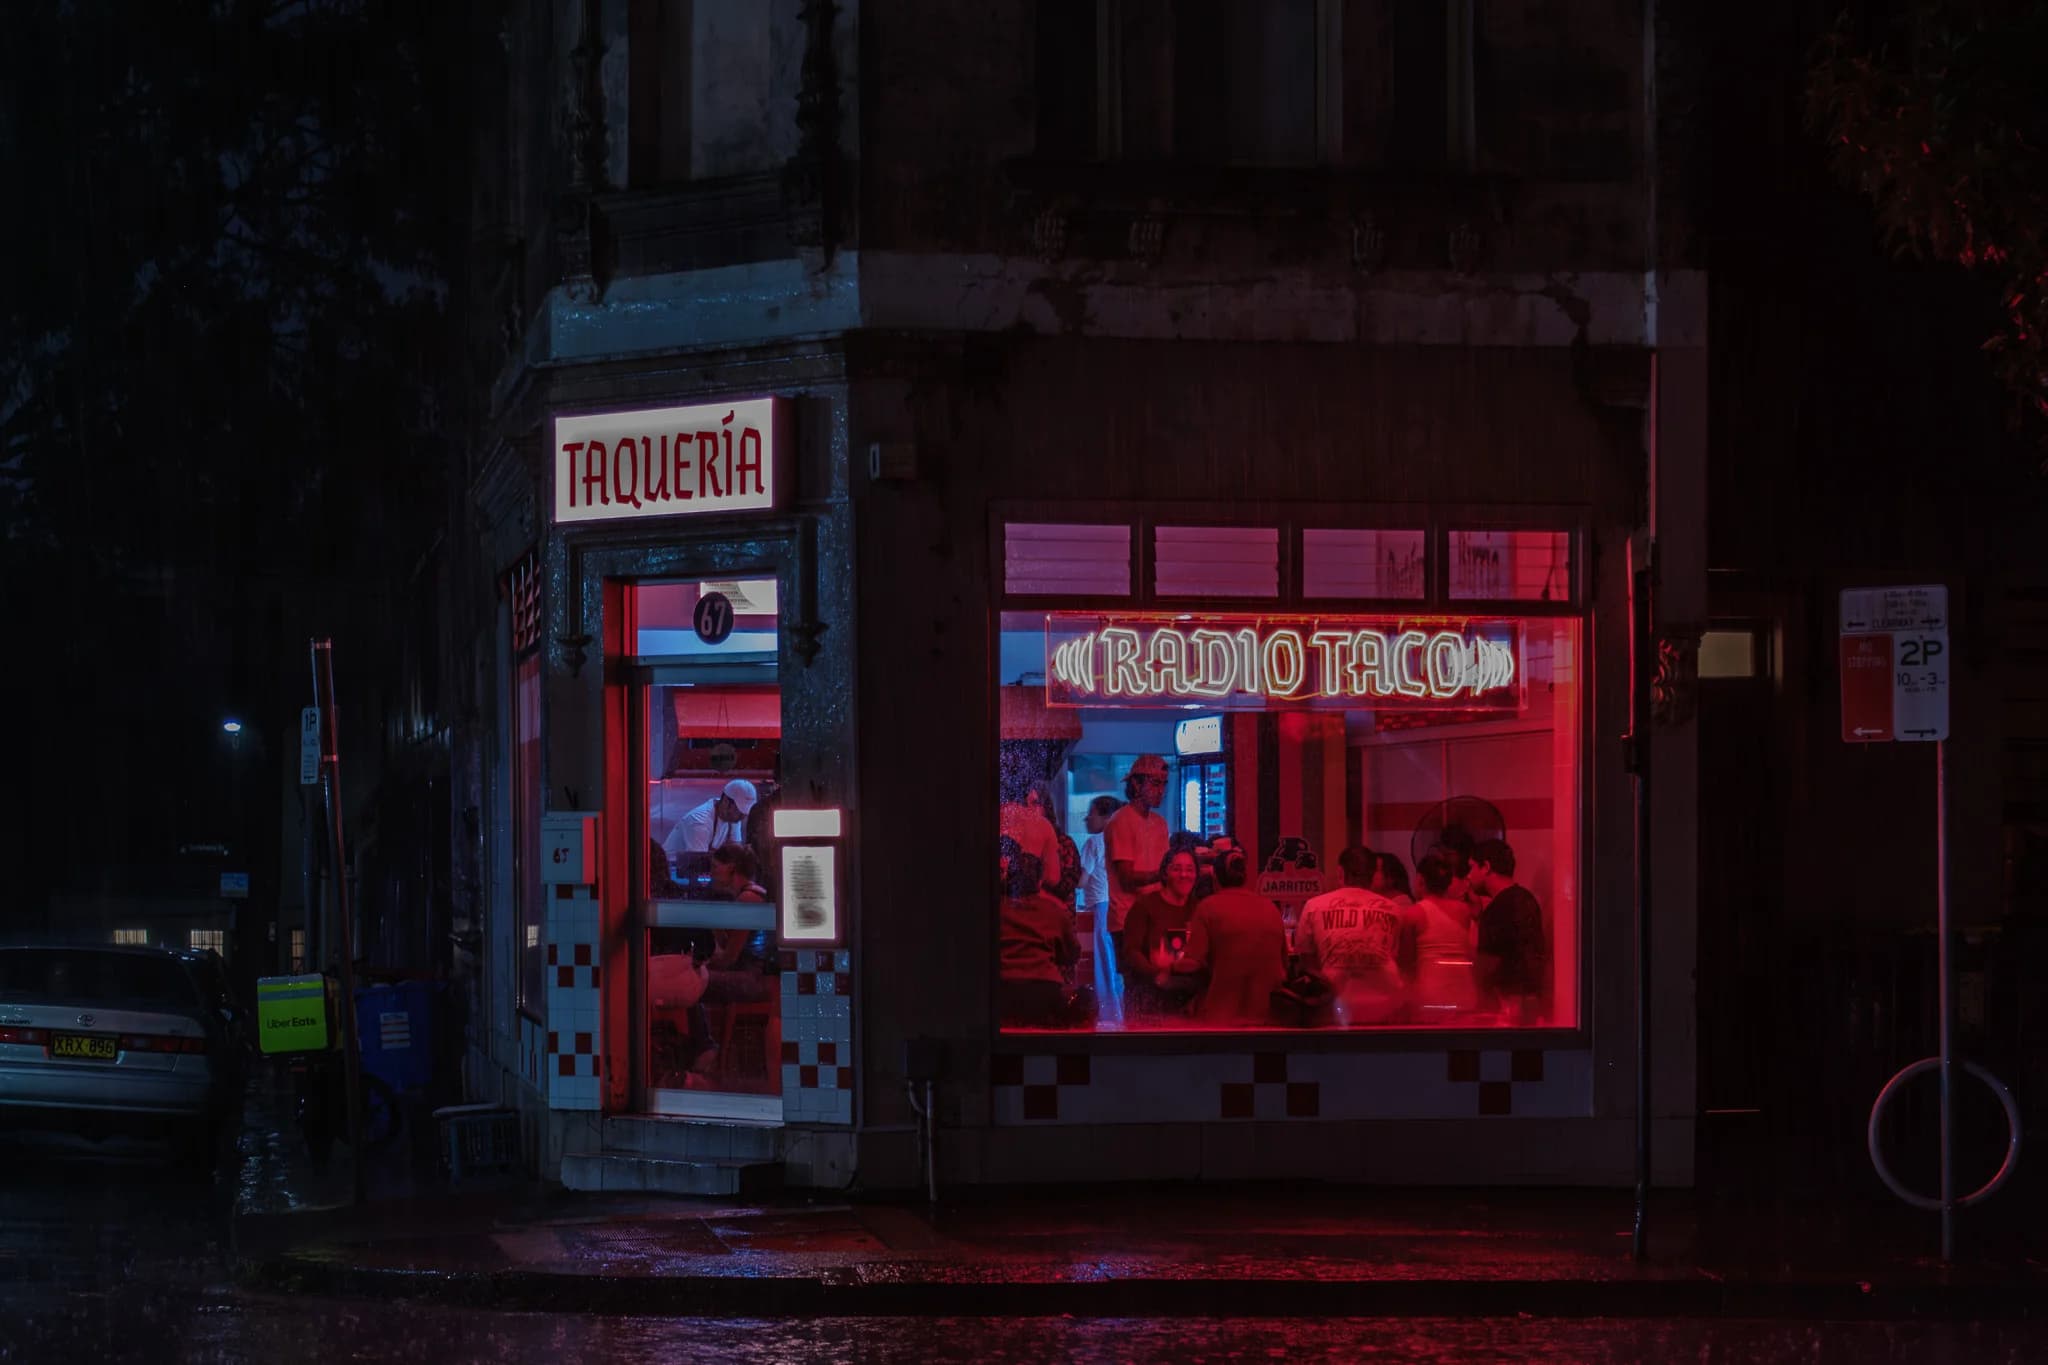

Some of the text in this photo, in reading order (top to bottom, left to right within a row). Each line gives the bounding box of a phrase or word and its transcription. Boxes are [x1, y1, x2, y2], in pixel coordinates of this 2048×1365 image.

[562, 410, 765, 510] TAQUERÍA
[701, 601, 726, 637] 67
[1101, 628, 1467, 698] RADIO TACO
[1900, 640, 1943, 666] 2P
[1263, 880, 1320, 893] JARRITOS
[1322, 909, 1358, 930] WILD
